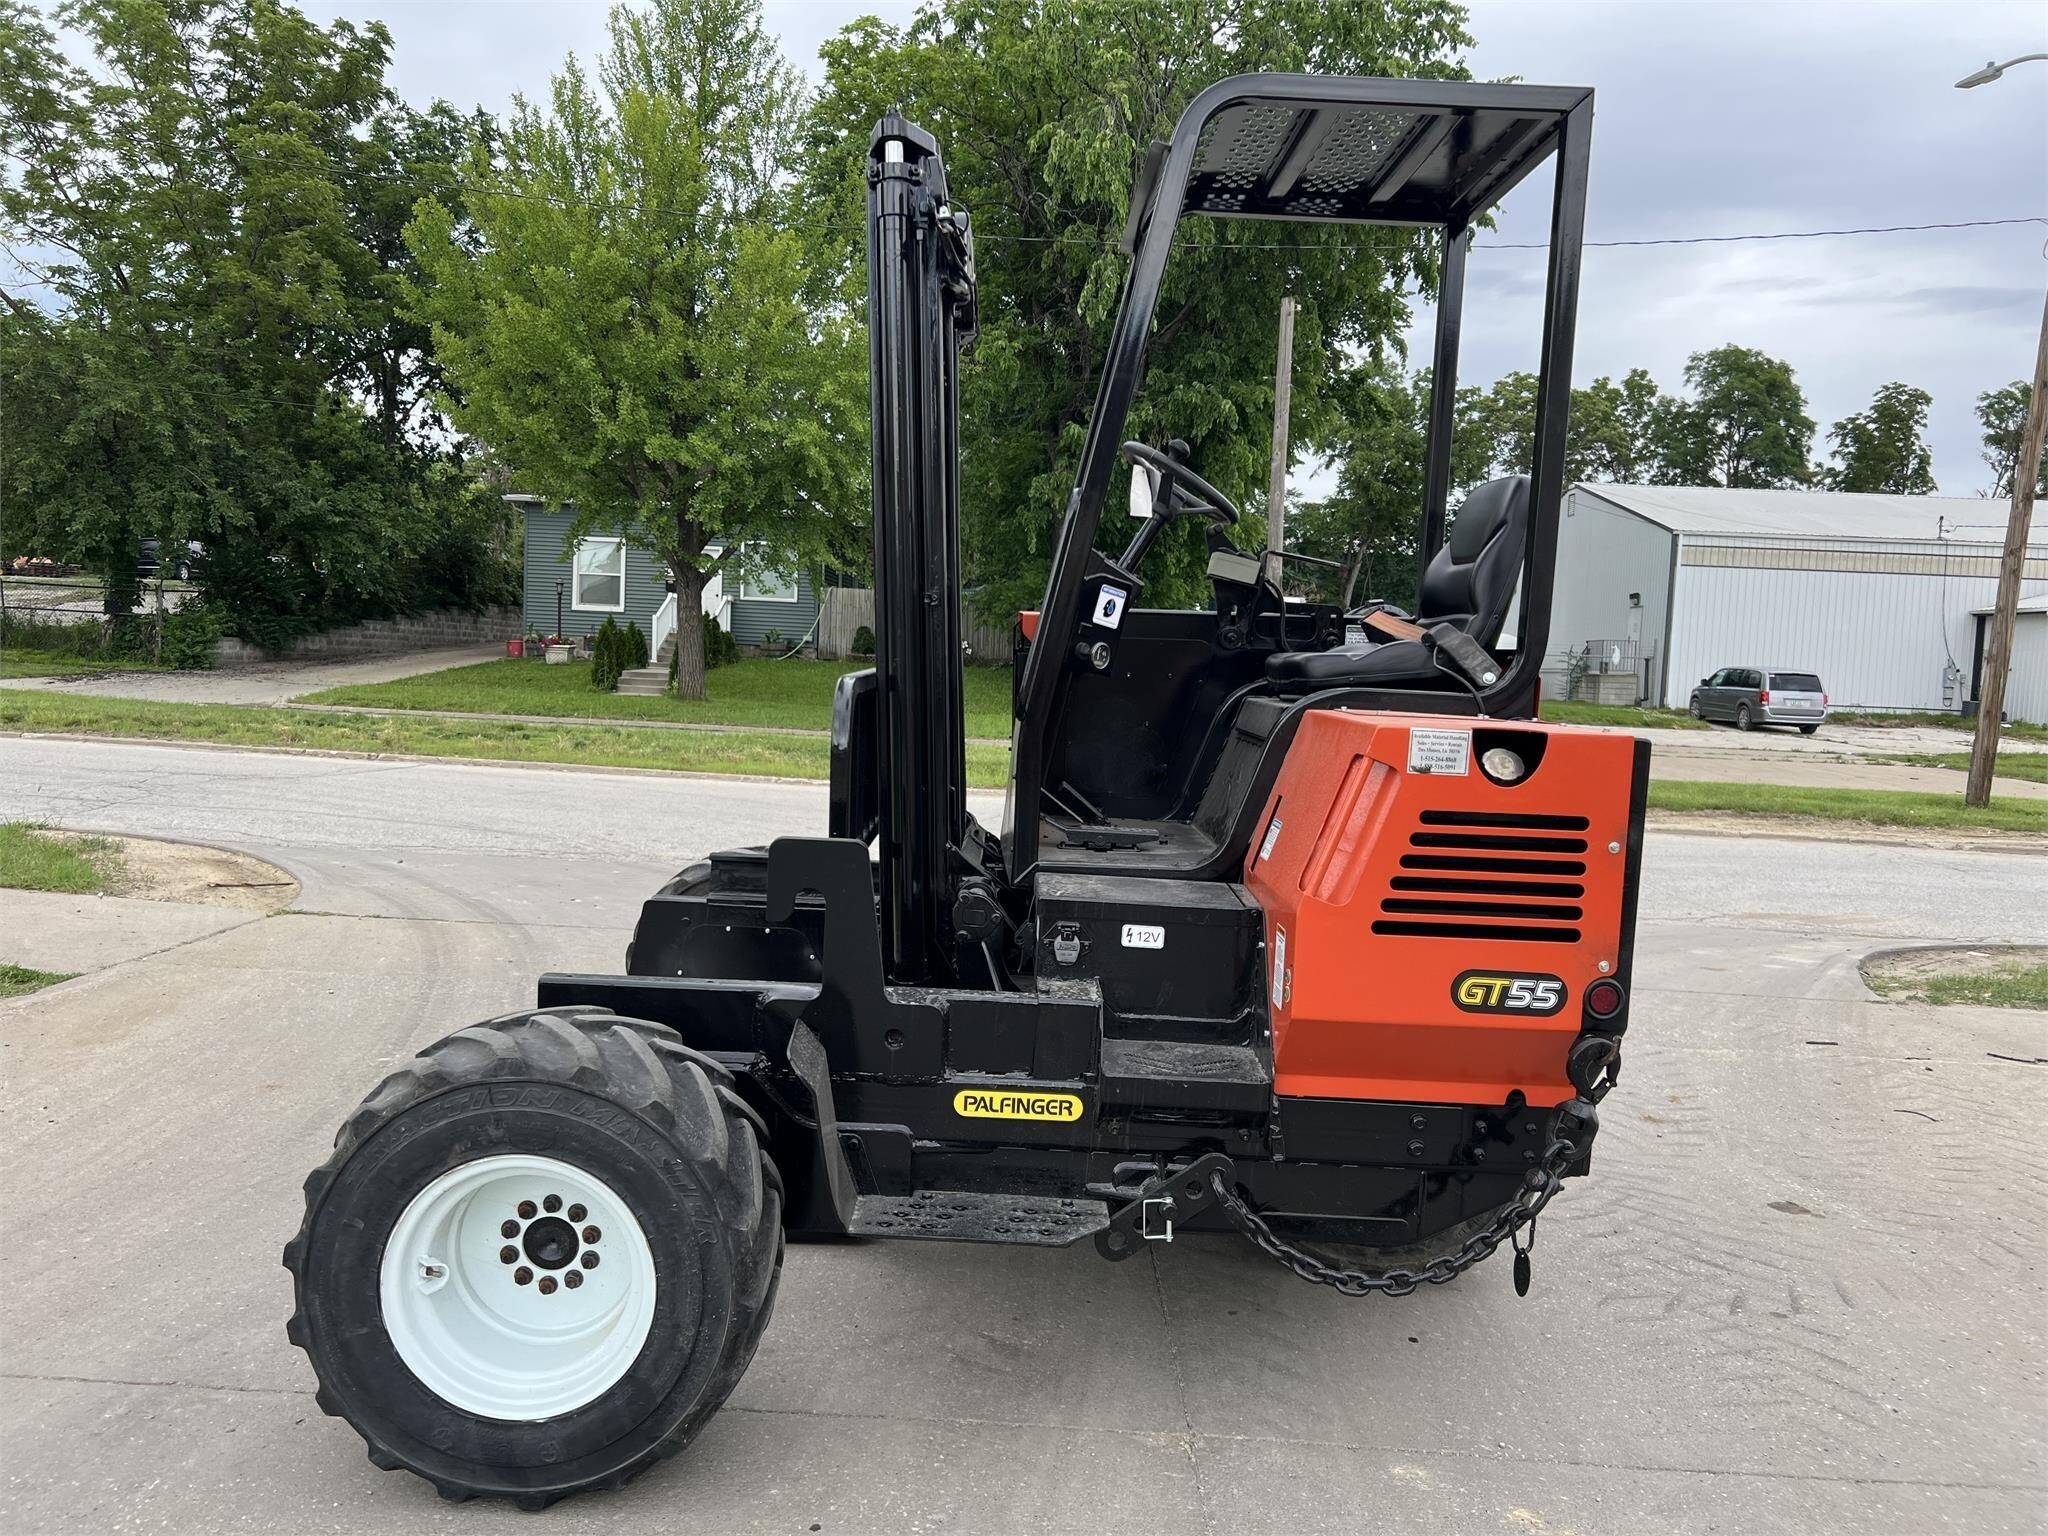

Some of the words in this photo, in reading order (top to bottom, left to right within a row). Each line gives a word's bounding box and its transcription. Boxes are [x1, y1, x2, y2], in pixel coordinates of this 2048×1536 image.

[1137, 931, 1161, 943] 12V
[1457, 976, 1562, 1010] GT55
[963, 1095, 1073, 1116] PALFINGER
